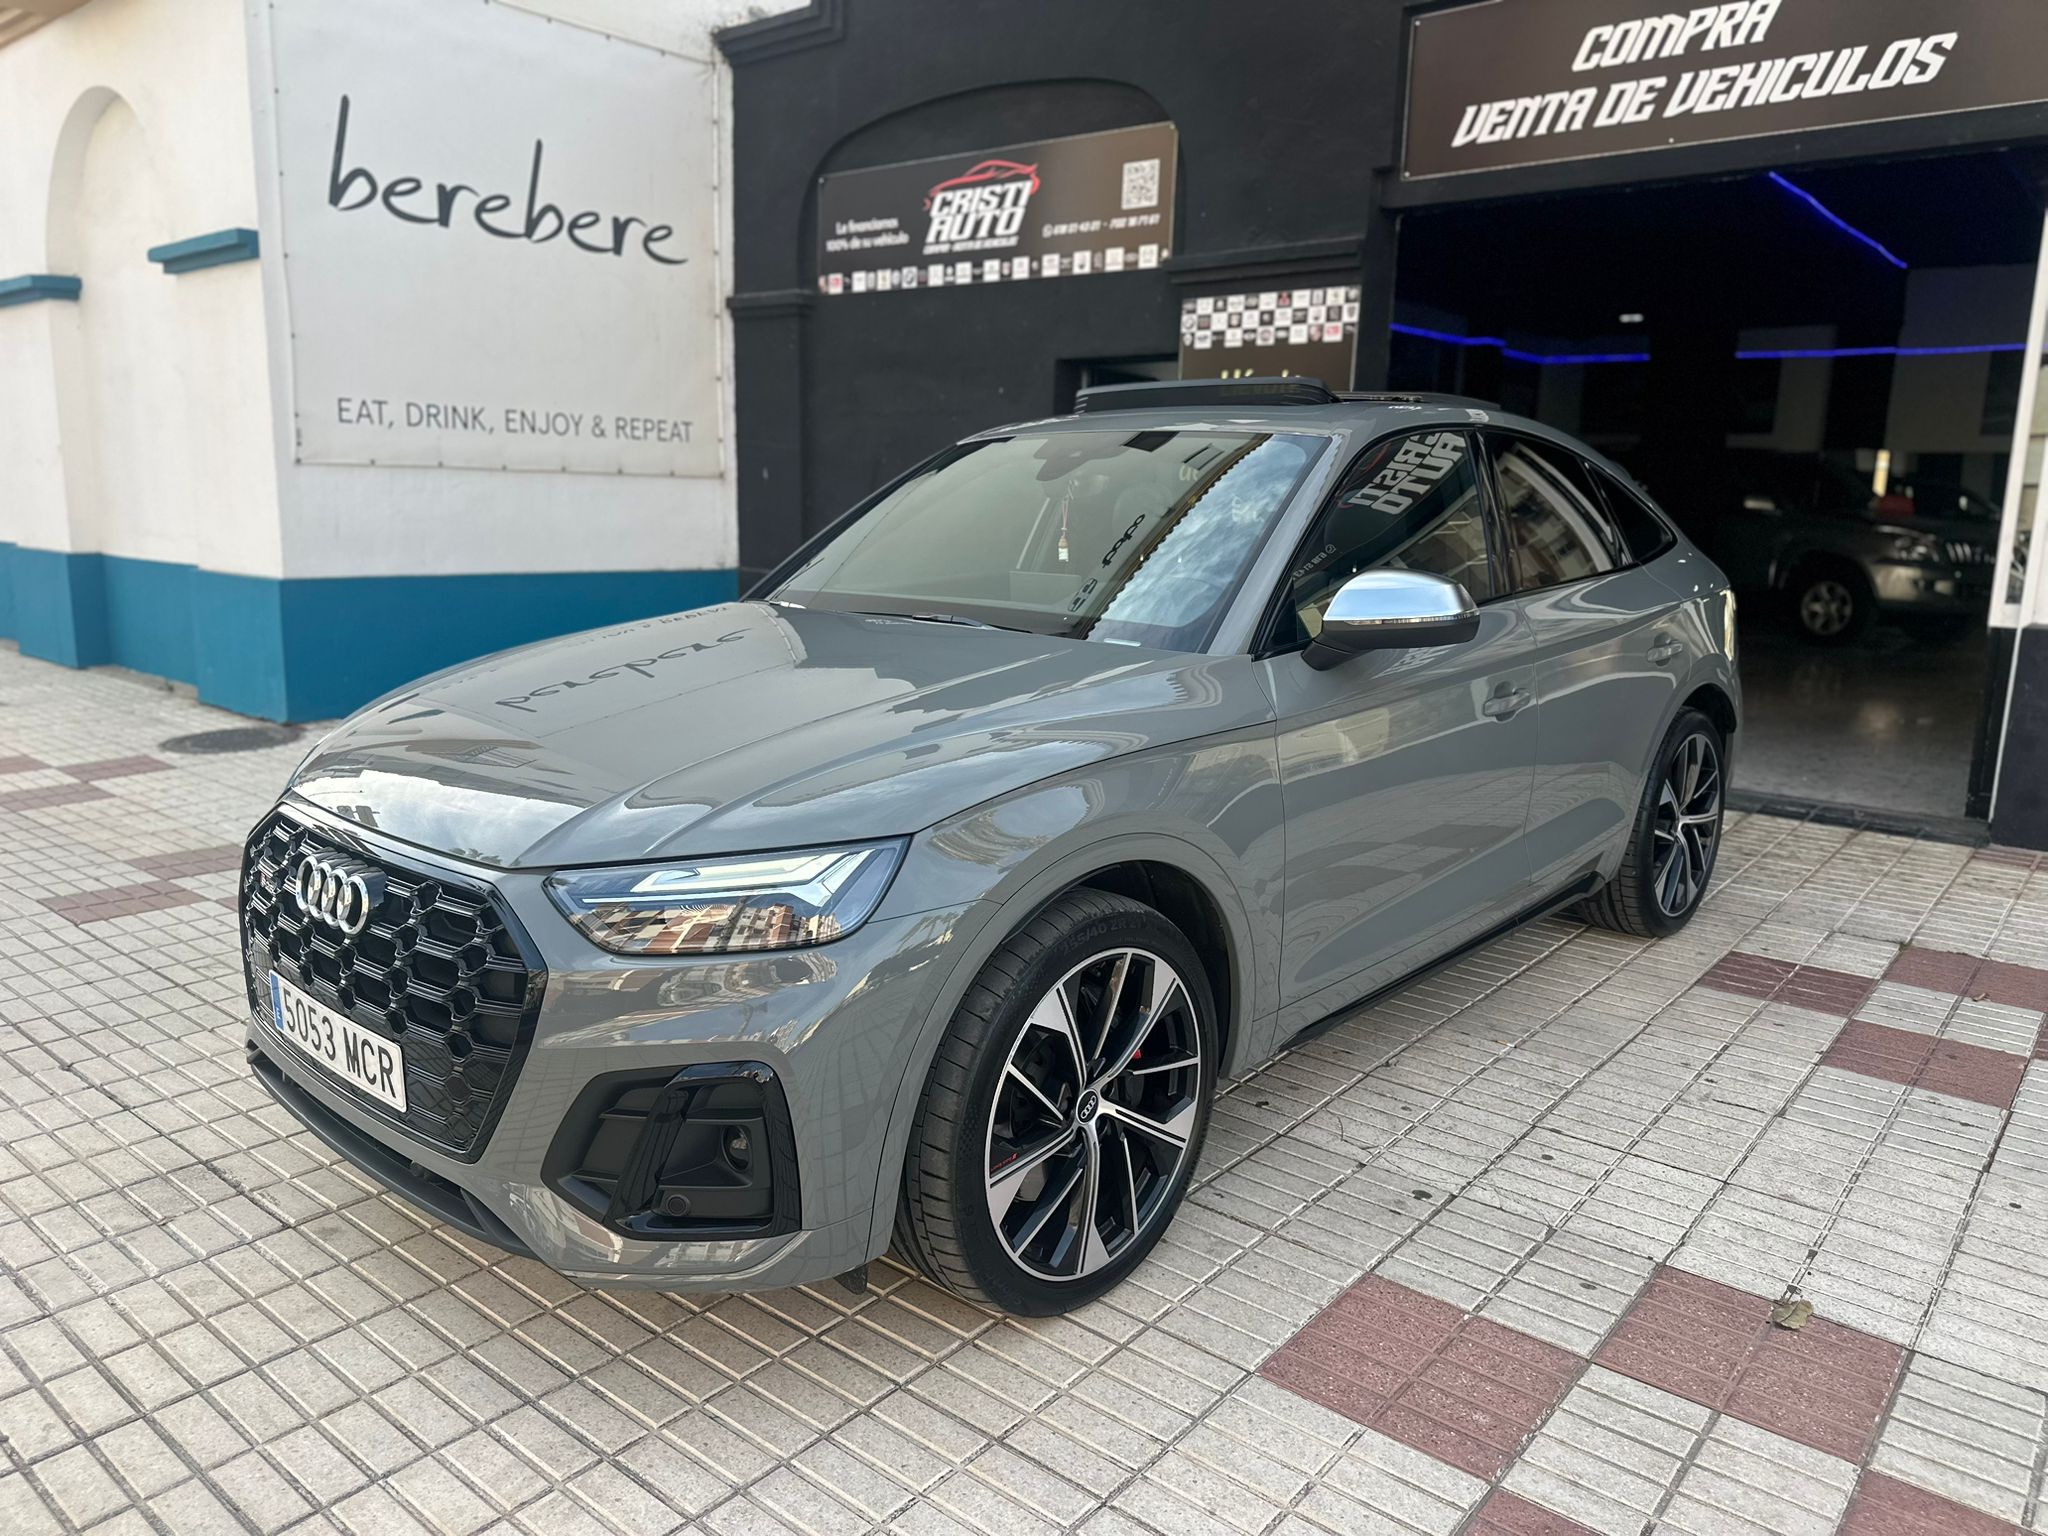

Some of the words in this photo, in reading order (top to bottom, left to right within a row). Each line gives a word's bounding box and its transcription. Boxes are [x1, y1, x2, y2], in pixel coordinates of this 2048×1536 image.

[1572, 0, 1783, 72] COMPRA
[1451, 87, 1598, 147] VENTA
[1593, 77, 1668, 127] DE
[1663, 32, 1958, 118] VEHICULOS
[329, 94, 689, 265] berebere
[930, 180, 1033, 217] CRISTI
[925, 208, 1026, 243] AUTO
[337, 398, 395, 430] EAT,
[405, 402, 495, 435] DRINK,
[504, 409, 583, 437] ENJOY
[591, 416, 607, 437] &
[615, 417, 693, 443] REPEAT
[283, 990, 336, 1062] 5053
[342, 1026, 397, 1098] MCR
